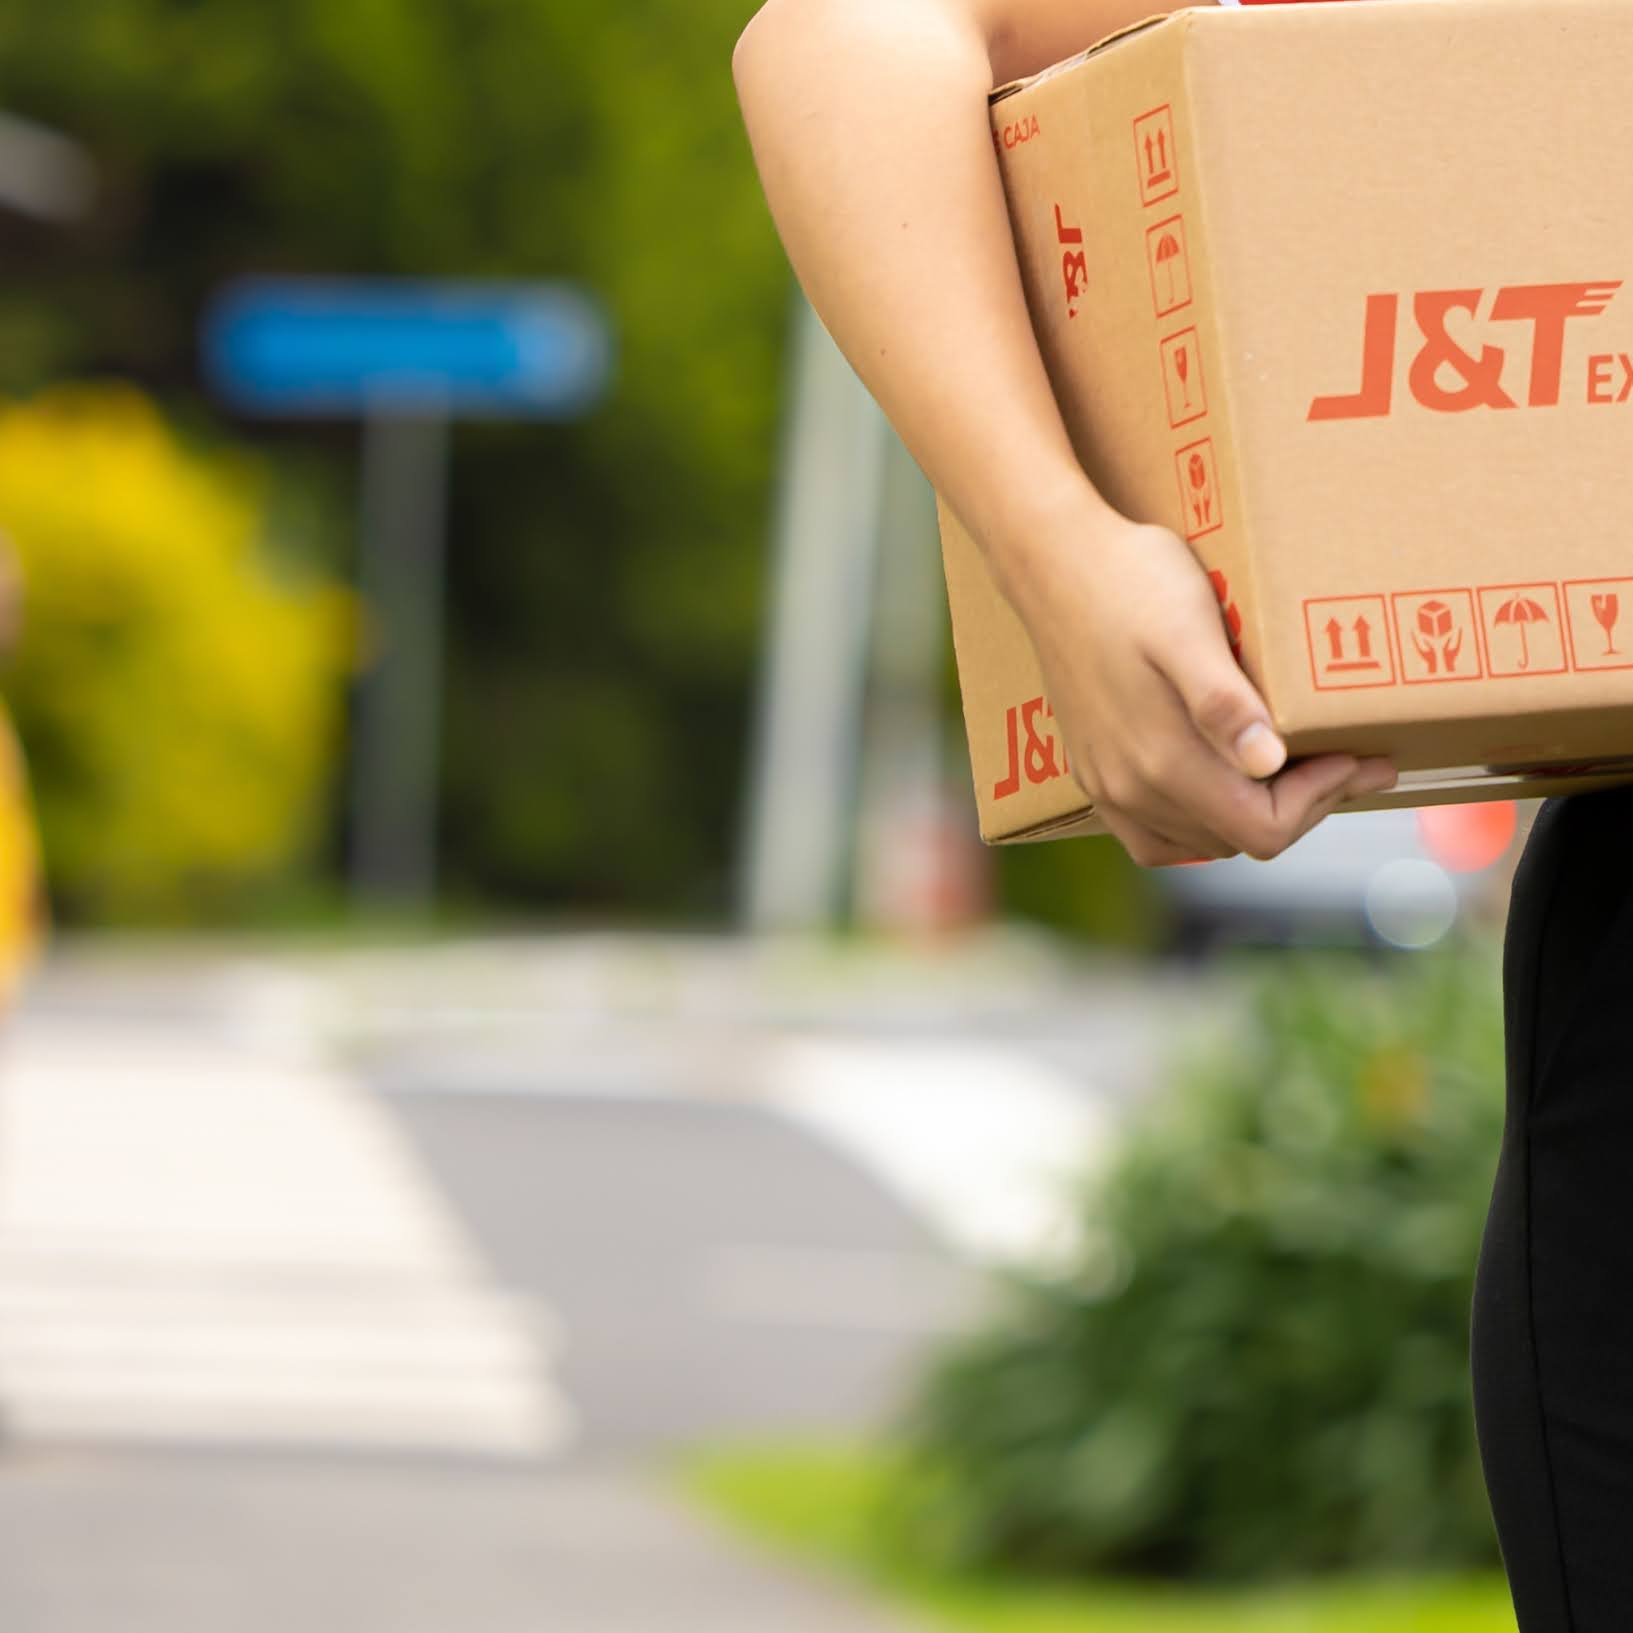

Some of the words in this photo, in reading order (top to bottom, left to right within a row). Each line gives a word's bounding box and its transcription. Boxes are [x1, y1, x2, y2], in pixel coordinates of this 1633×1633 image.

[1003, 114, 1041, 149] CAJA
[1306, 280, 1624, 422] J&T
[993, 696, 1070, 801] J&
